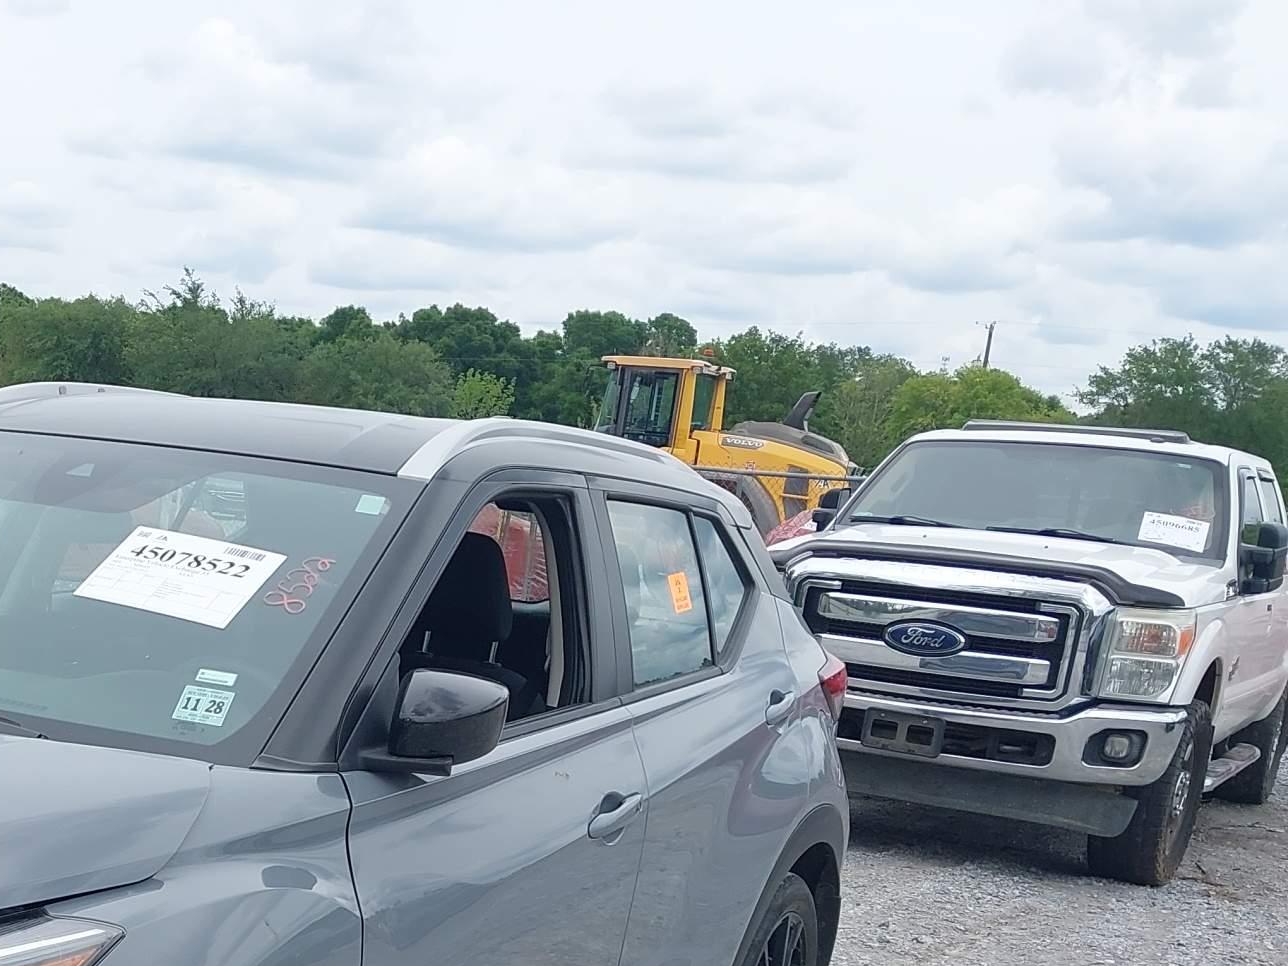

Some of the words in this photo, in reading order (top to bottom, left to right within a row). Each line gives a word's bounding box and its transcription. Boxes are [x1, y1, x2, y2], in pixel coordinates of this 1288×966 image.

[724, 436, 764, 448] VOLVO
[130, 544, 252, 579] 45078522
[263, 555, 337, 615] 8522
[901, 626, 947, 648] Ford
[181, 696, 202, 712] 11
[204, 699, 226, 715] 28
